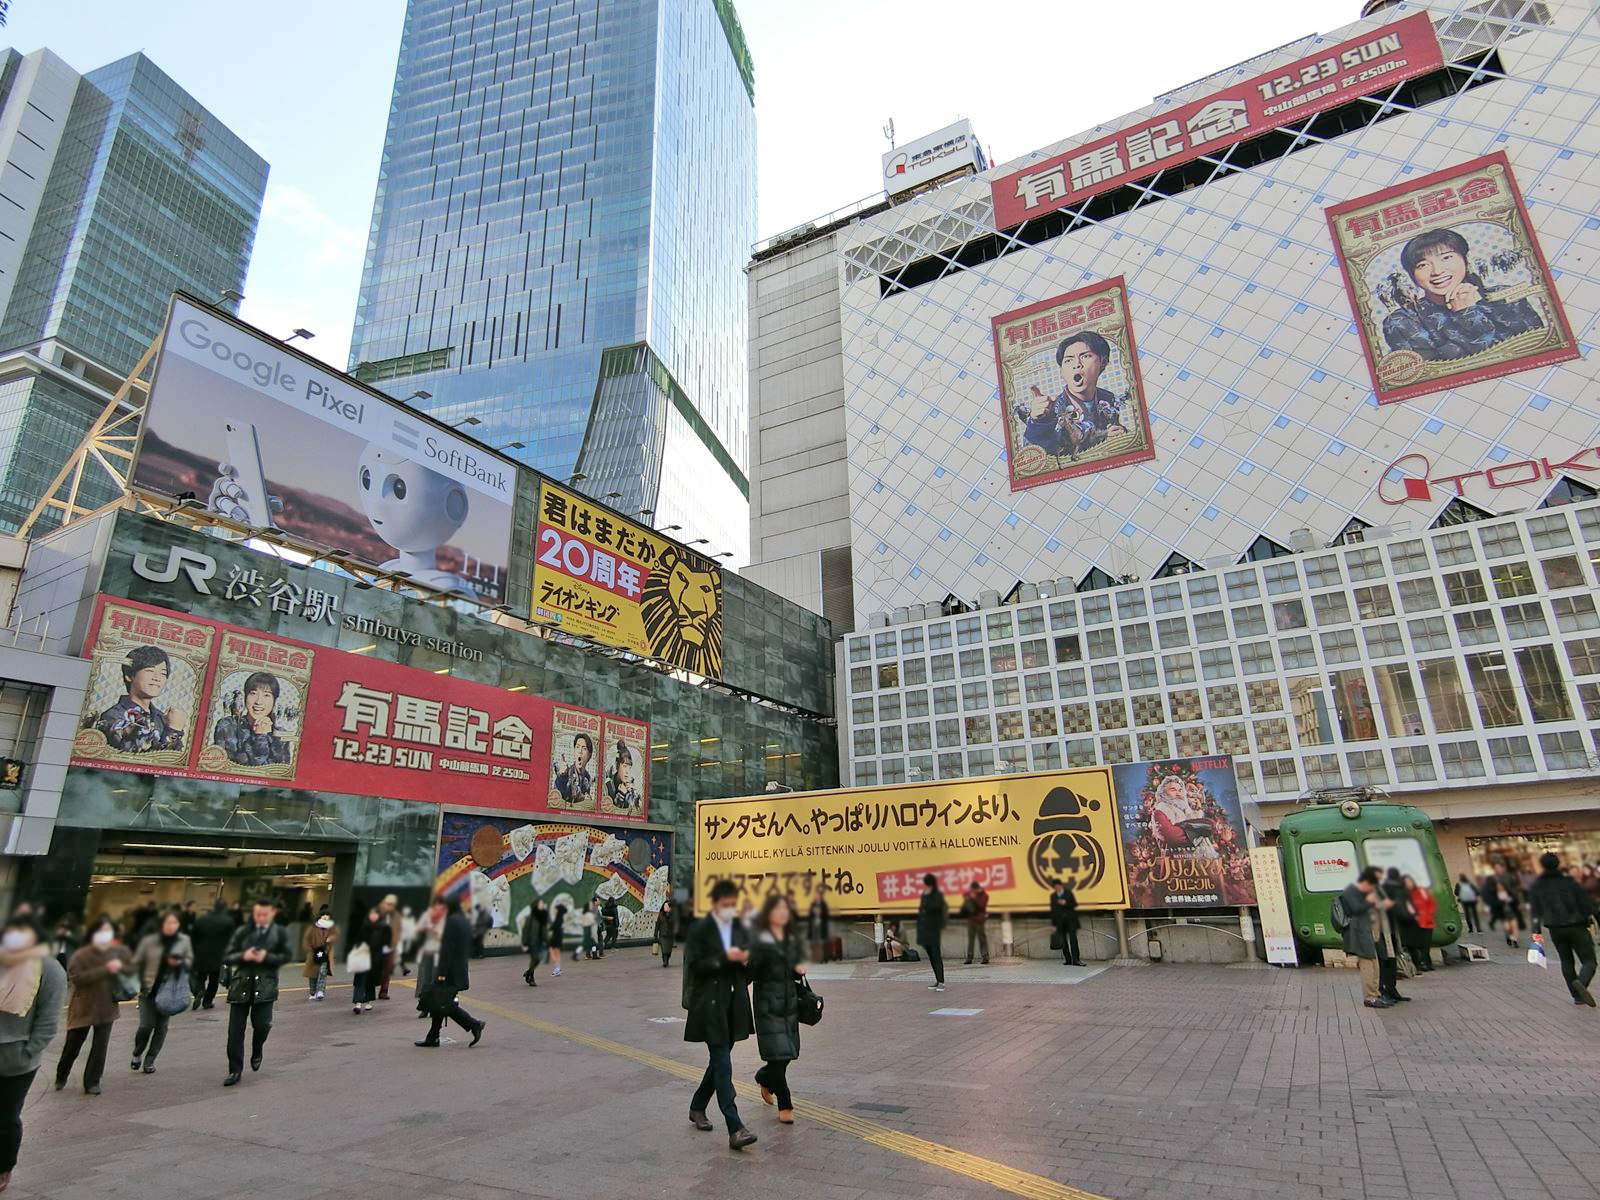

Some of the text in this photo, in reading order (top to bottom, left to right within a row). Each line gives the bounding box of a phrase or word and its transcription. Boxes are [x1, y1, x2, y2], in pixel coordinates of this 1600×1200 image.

[1257, 57, 1339, 101] 12.23
[1341, 32, 1402, 69] SUN
[907, 142, 968, 171] TOKYU
[1014, 99, 1251, 210] 有馬記念
[1345, 177, 1500, 238] 有馬記念
[1004, 297, 1116, 346] 有馬記念
[180, 318, 508, 493] Google Pixel SoftBank
[1430, 446, 1600, 497] TOK
[543, 491, 661, 569] 君はまだか。
[459, 552, 500, 586] 11.1
[539, 529, 641, 597] 20周年
[133, 545, 484, 663] JR 渋谷駅 shibuya station
[540, 580, 621, 622] ライオンキング
[110, 609, 207, 648] 有馬記念
[227, 635, 308, 670] 有馬記念
[335, 681, 534, 761] 有馬記念
[333, 737, 393, 766] 12.23
[394, 747, 434, 771] SUN
[1191, 758, 1229, 772] NETFLIX
[704, 792, 1021, 841] サンタさんへ。やっぱりハロウィンより、
[705, 835, 1022, 861] JOULUPUKILLE, KYLLÄ SITTENKIN JOULU VOITTÄÄ HALLOWEENIN.
[704, 867, 865, 898] クスマスですよね。
[882, 863, 1009, 899] #よそサンタ
